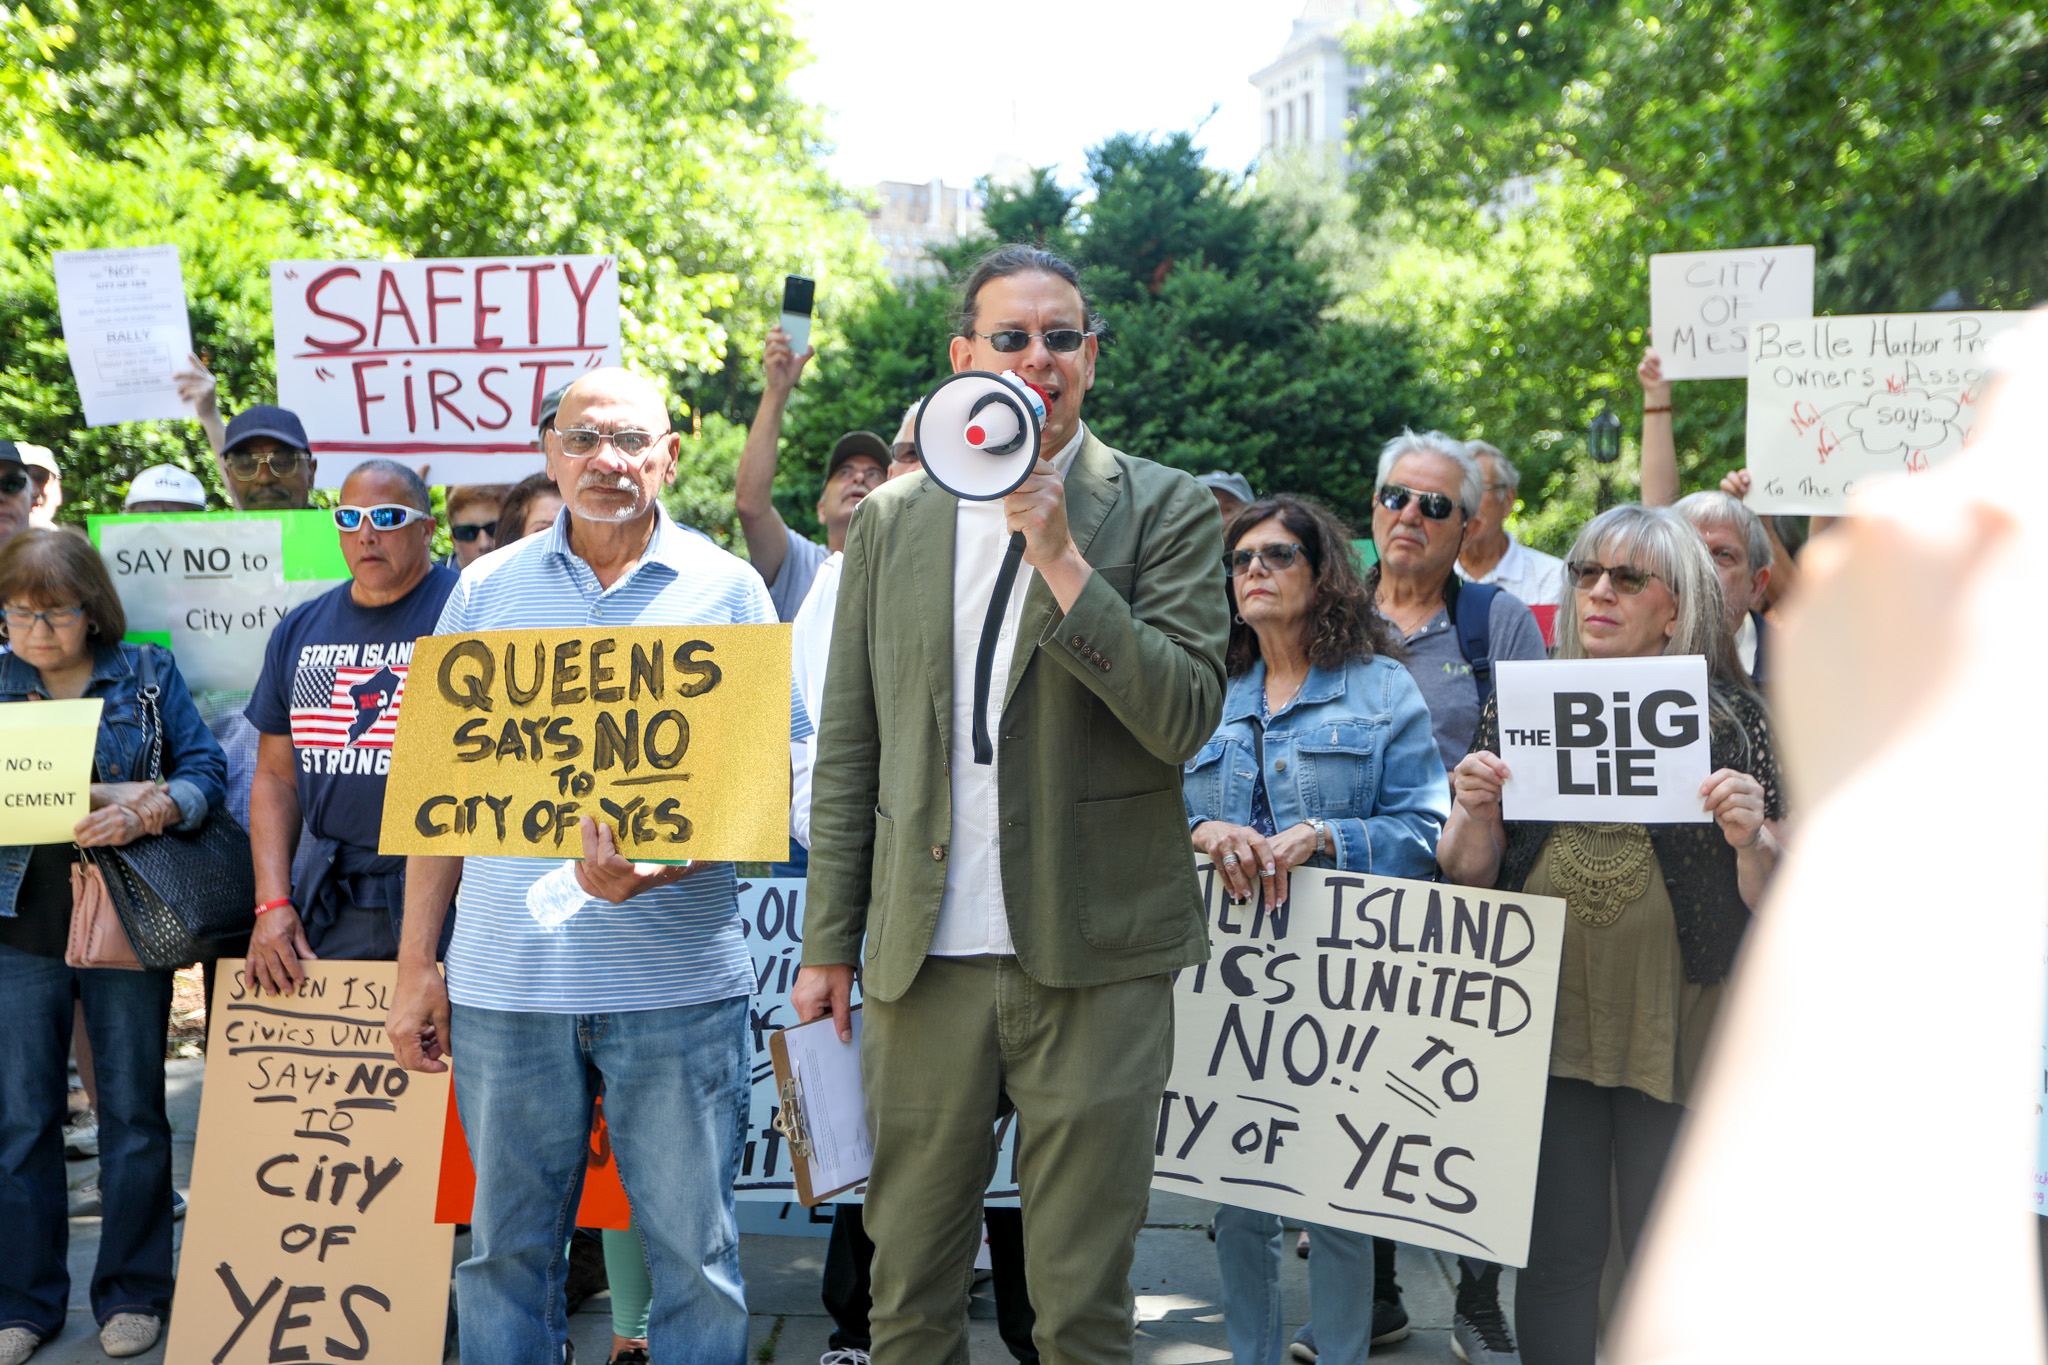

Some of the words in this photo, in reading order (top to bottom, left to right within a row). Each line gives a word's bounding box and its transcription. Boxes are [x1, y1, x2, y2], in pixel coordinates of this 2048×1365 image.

[1686, 256, 1777, 291] CITY
[1700, 295, 1754, 327] OF
[106, 328, 150, 344] RALLY
[1673, 326, 1746, 360] MES
[1755, 321, 1853, 362] Belle
[1870, 317, 1943, 359] Harbor
[1773, 364, 1875, 389] Owners
[1798, 476, 1833, 498] The
[116, 548, 173, 575] SAY
[183, 547, 232, 573] NO
[242, 550, 268, 572] to
[186, 608, 233, 635] City
[241, 605, 266, 629] of
[298, 643, 359, 667] STATEN
[437, 638, 722, 712] QUEENS
[452, 715, 584, 763] SAYS
[593, 708, 690, 774] NO
[1504, 729, 1551, 746] THE
[6, 757, 32, 772] NO
[38, 759, 53, 771] to
[301, 748, 392, 776] STRONG
[551, 764, 595, 798] TO
[4, 792, 77, 808] CEMENT
[415, 793, 513, 843] CITY
[522, 799, 583, 848] OF
[600, 795, 694, 845] YES
[1316, 876, 1535, 968] ISLAND
[230, 970, 327, 1000] STEN
[338, 976, 389, 1011] ISL
[331, 1024, 382, 1046] UNI
[1208, 1003, 1380, 1093] NO!!
[344, 1063, 409, 1097] NO
[1411, 1035, 1479, 1103] TO
[301, 1108, 354, 1132] TO
[1156, 1090, 1218, 1160] TY
[1231, 1117, 1299, 1164] OF
[1335, 1113, 1477, 1214] YES
[281, 1223, 356, 1262] OF
[212, 1261, 391, 1365] YES
